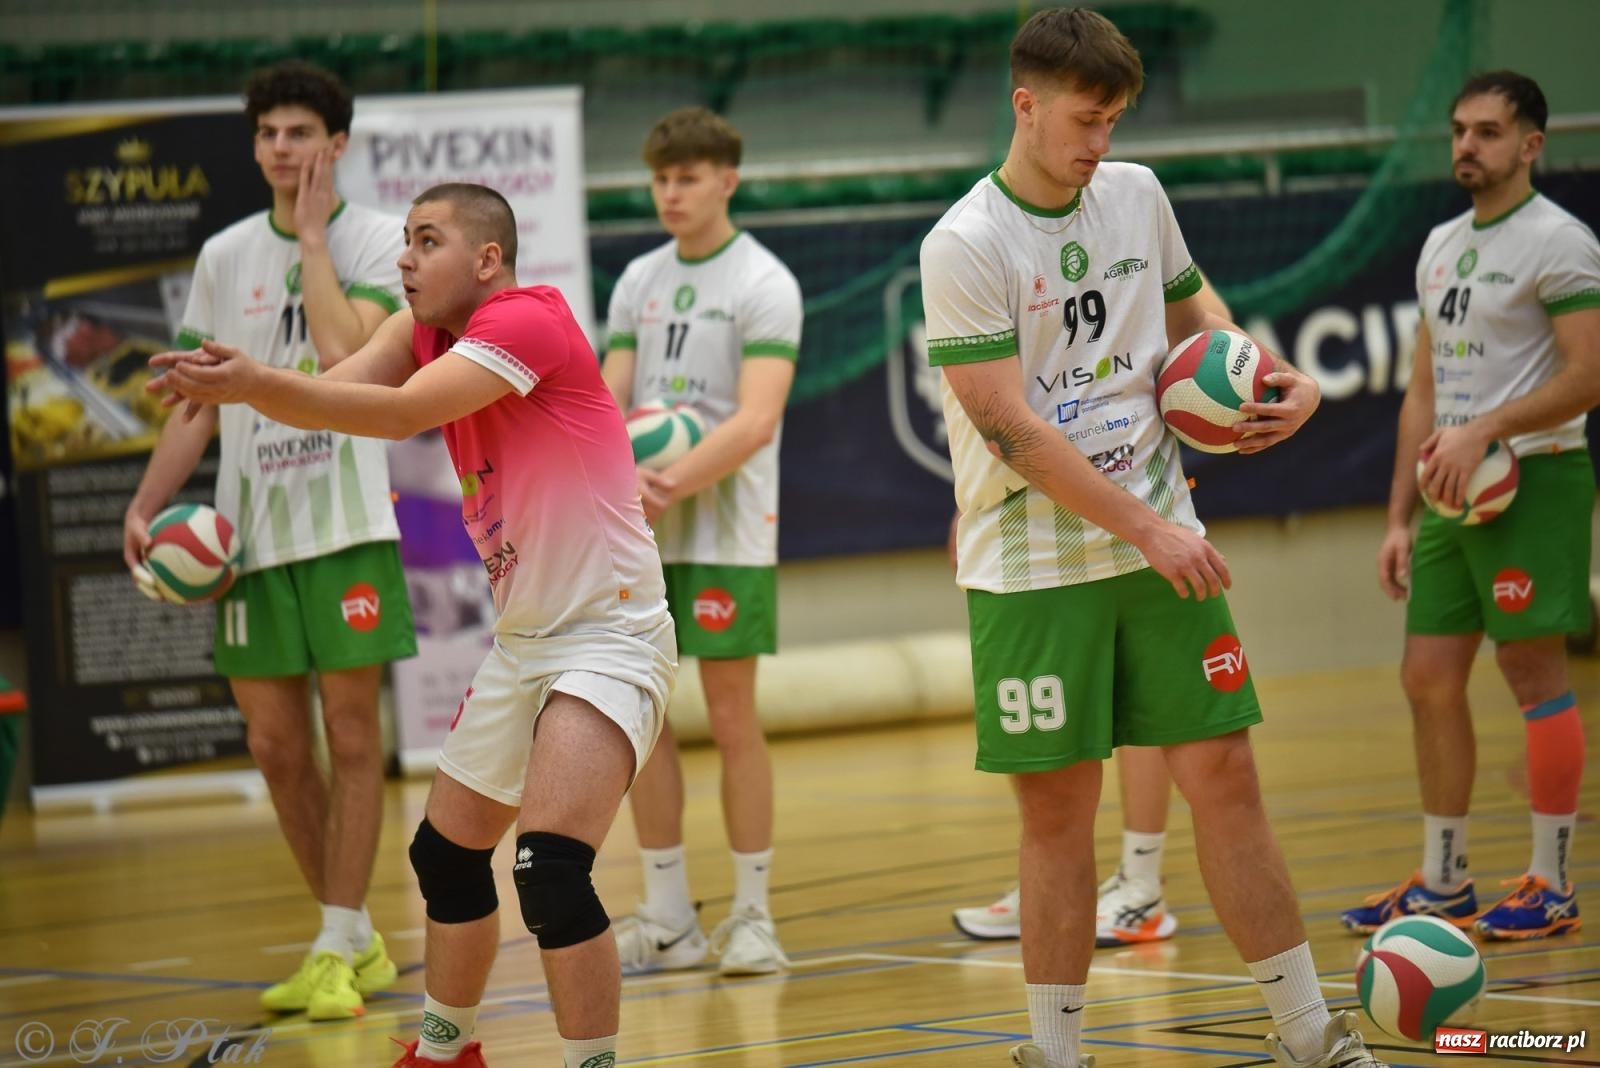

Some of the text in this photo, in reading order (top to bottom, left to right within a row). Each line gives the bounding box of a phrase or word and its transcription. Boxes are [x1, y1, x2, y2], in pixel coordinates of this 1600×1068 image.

[369, 127, 556, 172] PIVEXIN
[1063, 289, 1107, 350] 99
[1439, 286, 1471, 326] 49
[665, 322, 690, 361] 17
[1064, 410, 1141, 442] ierunekbmp.pl
[257, 431, 333, 462] PIVEXIN
[997, 674, 1067, 735] 99
